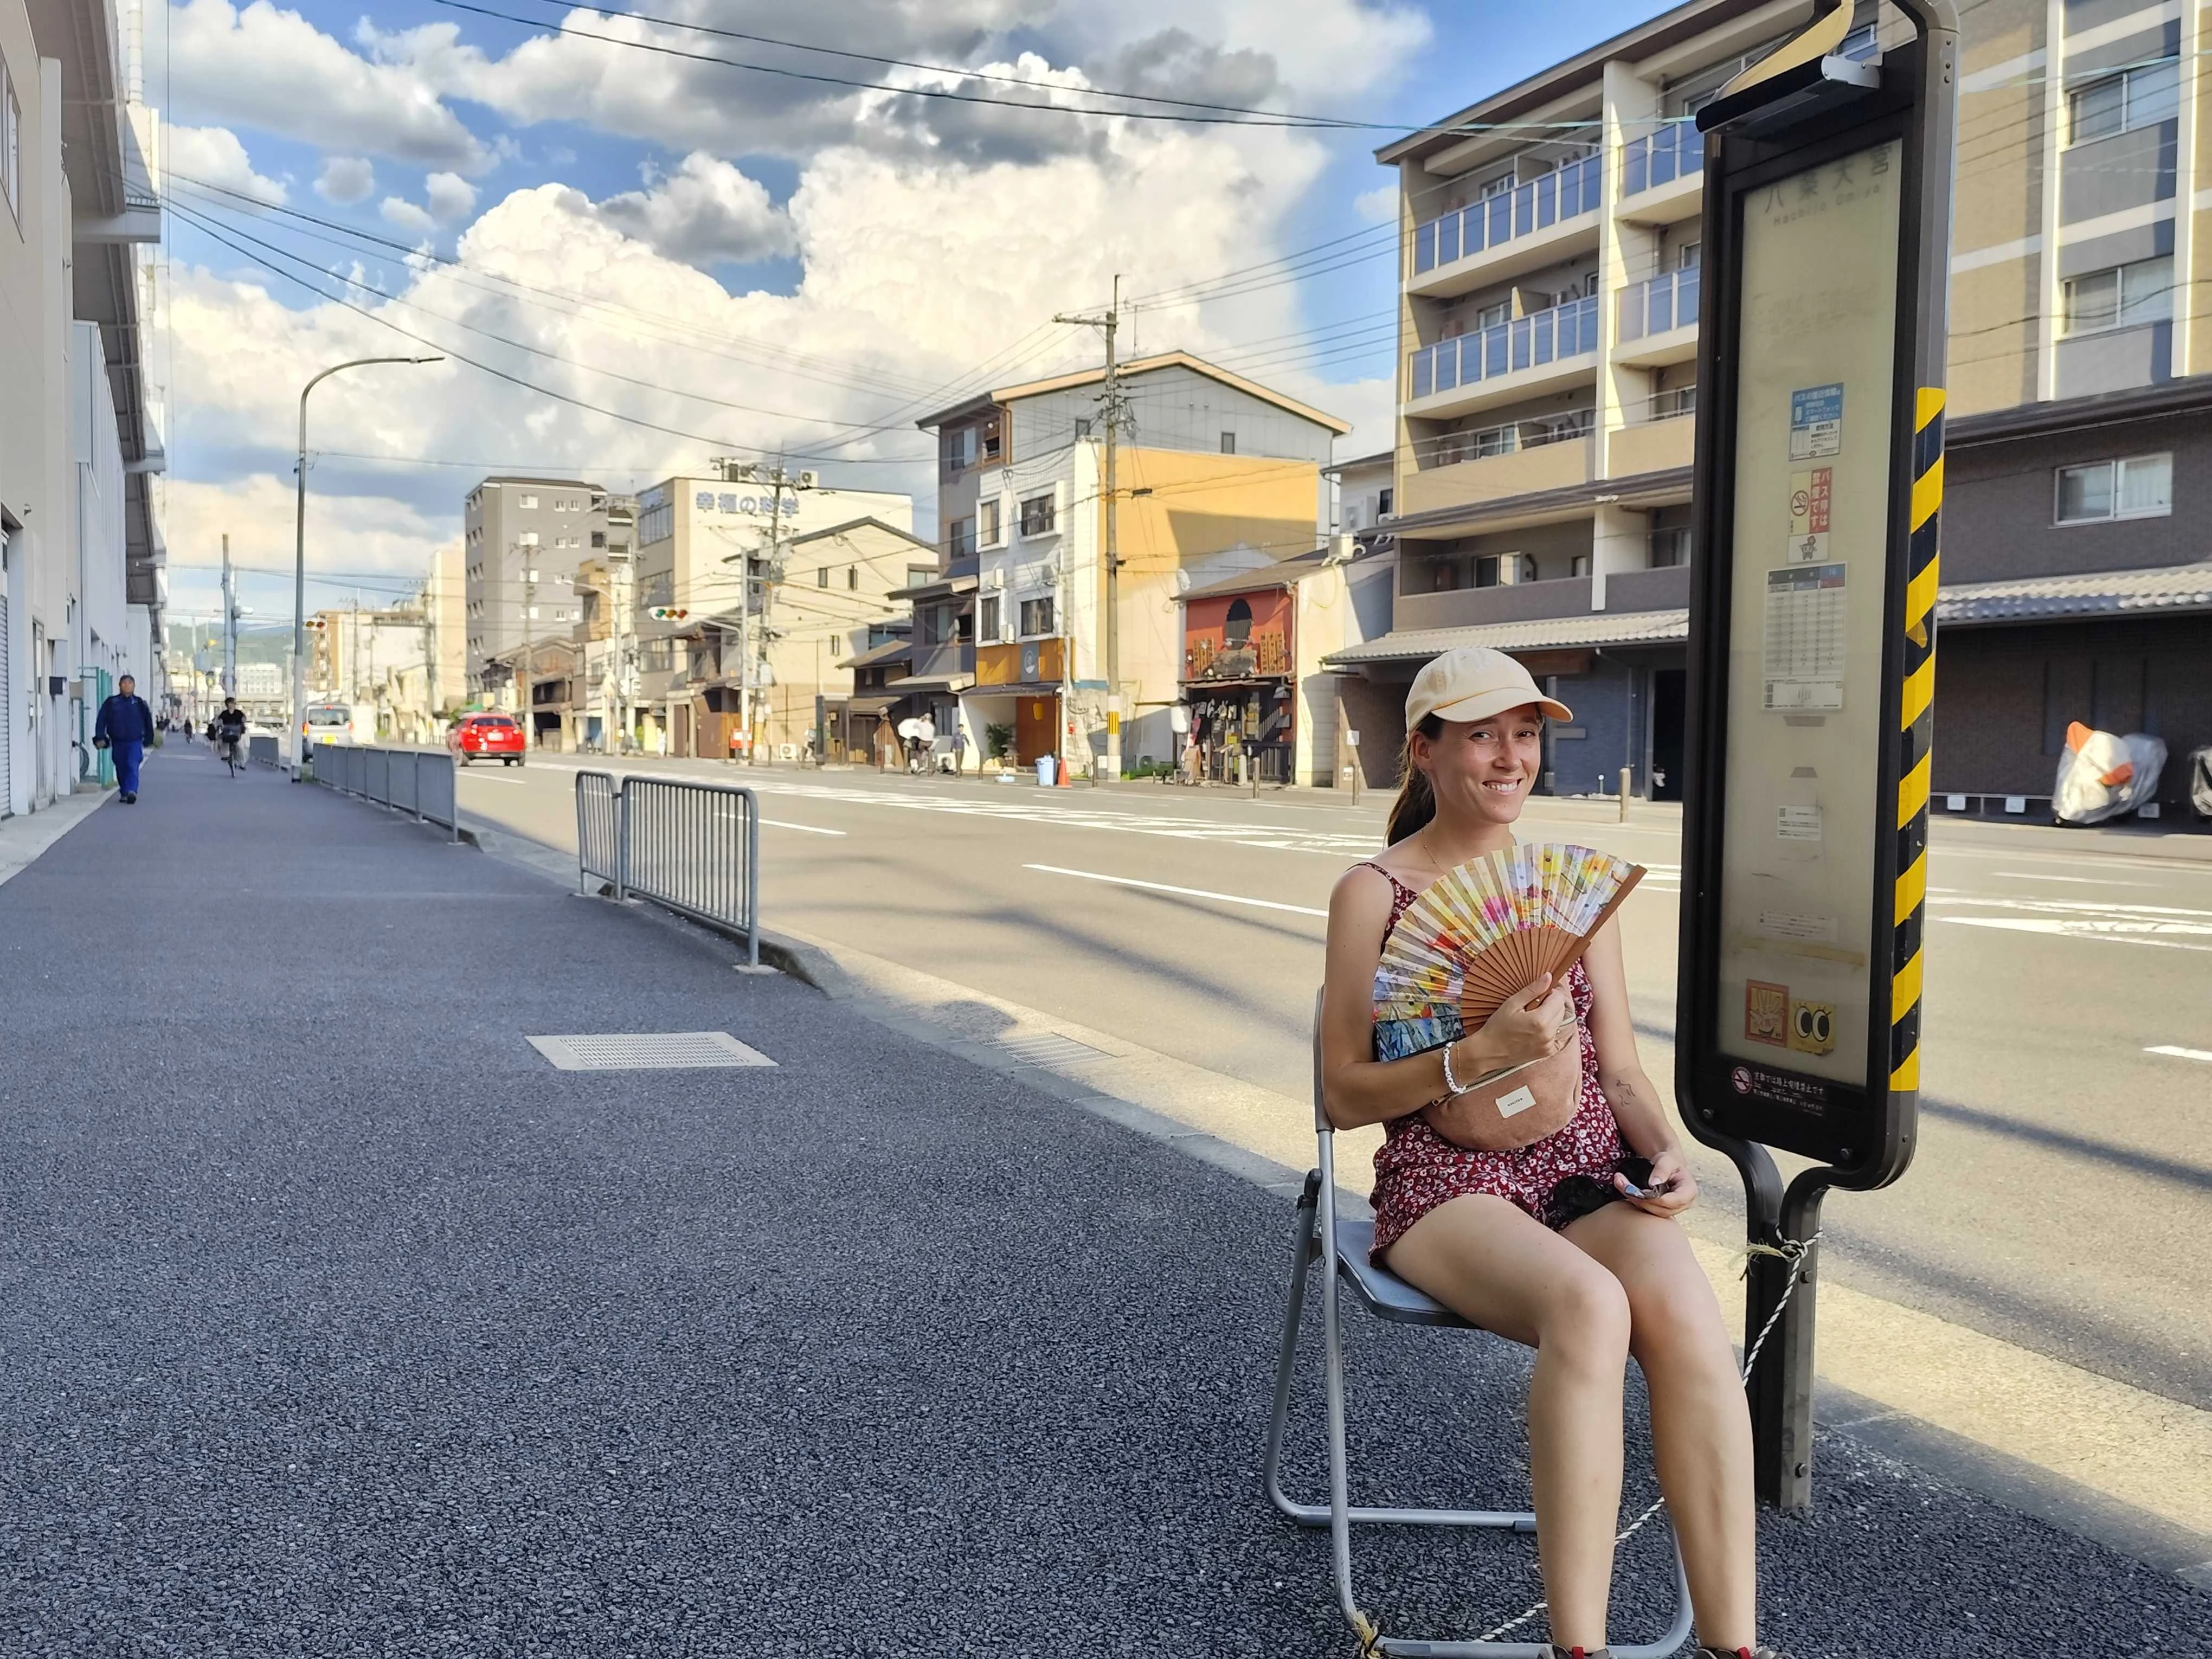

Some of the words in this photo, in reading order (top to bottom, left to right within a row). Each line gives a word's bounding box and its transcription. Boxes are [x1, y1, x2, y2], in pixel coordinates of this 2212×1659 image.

[696, 491, 800, 518] 幸福の科学
